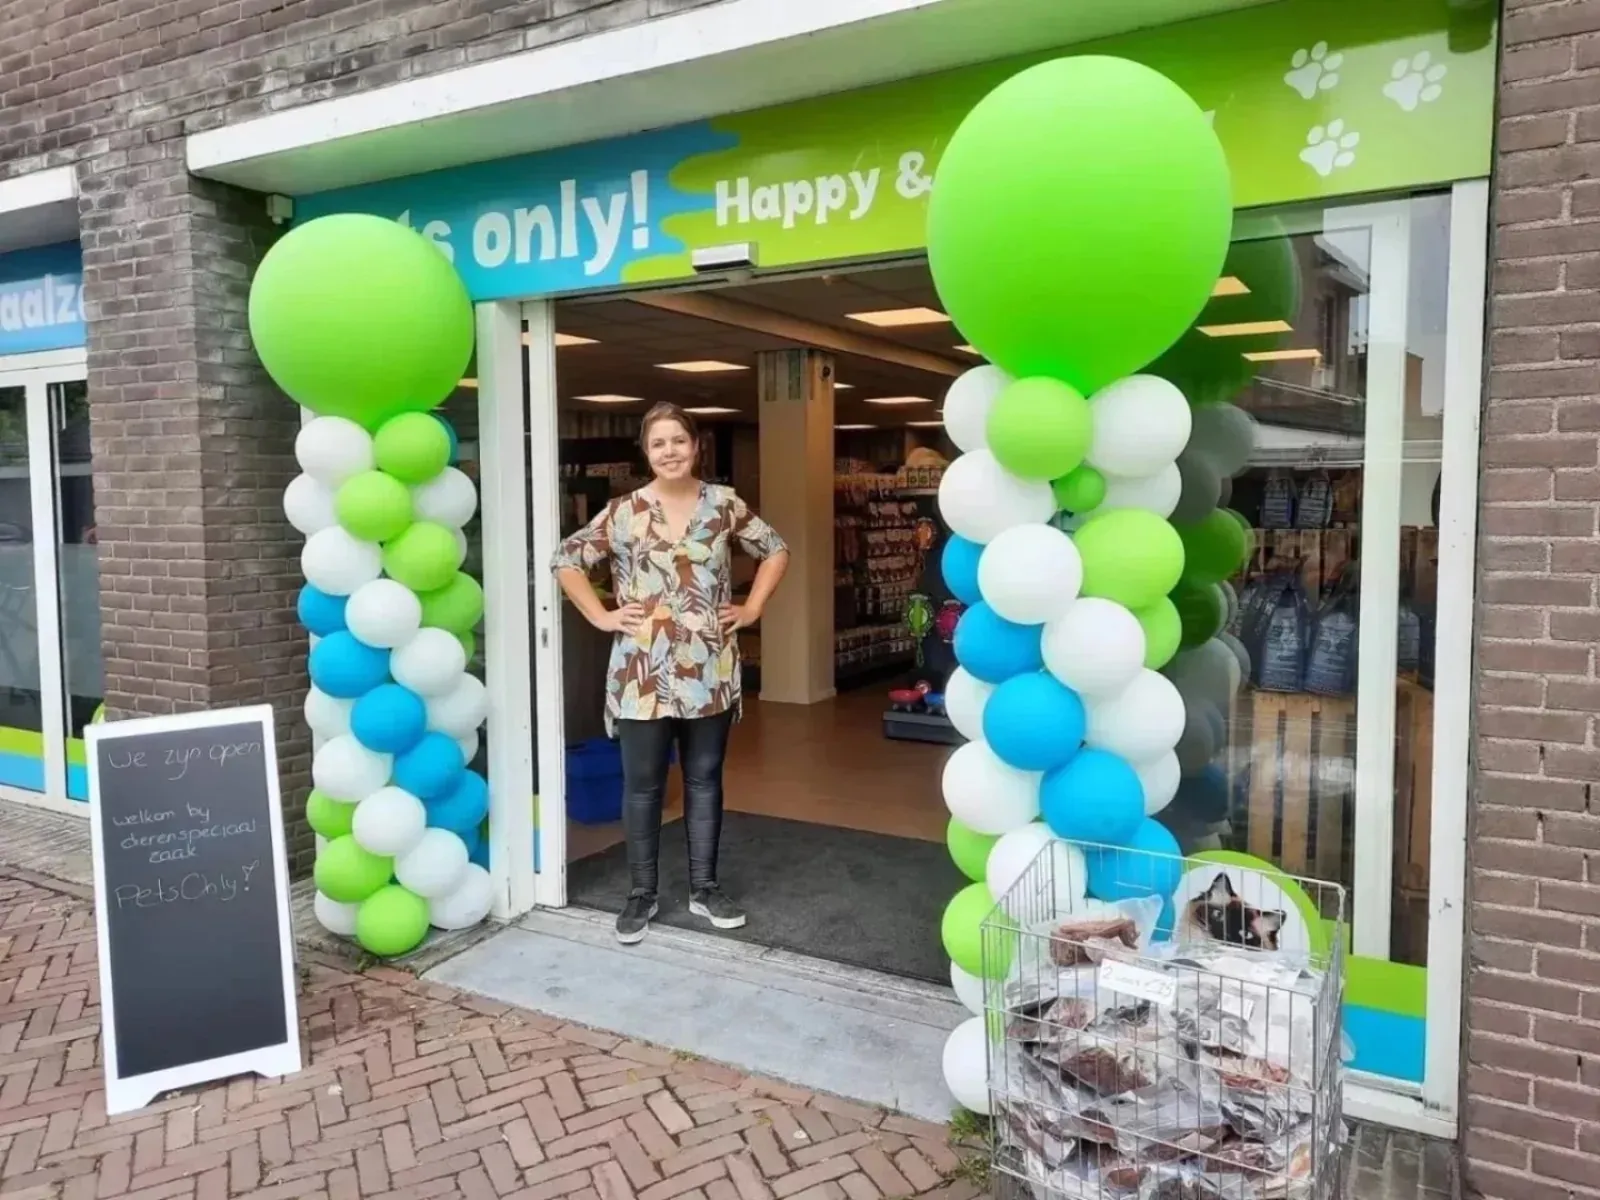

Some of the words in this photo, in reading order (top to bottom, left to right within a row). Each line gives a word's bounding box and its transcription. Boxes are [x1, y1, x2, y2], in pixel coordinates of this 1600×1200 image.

[715, 166, 880, 229] Happy
[895, 150, 932, 198] &
[472, 169, 649, 277] only!
[0, 271, 88, 332] aalz
[209, 741, 261, 767] open
[112, 808, 176, 826] welkom
